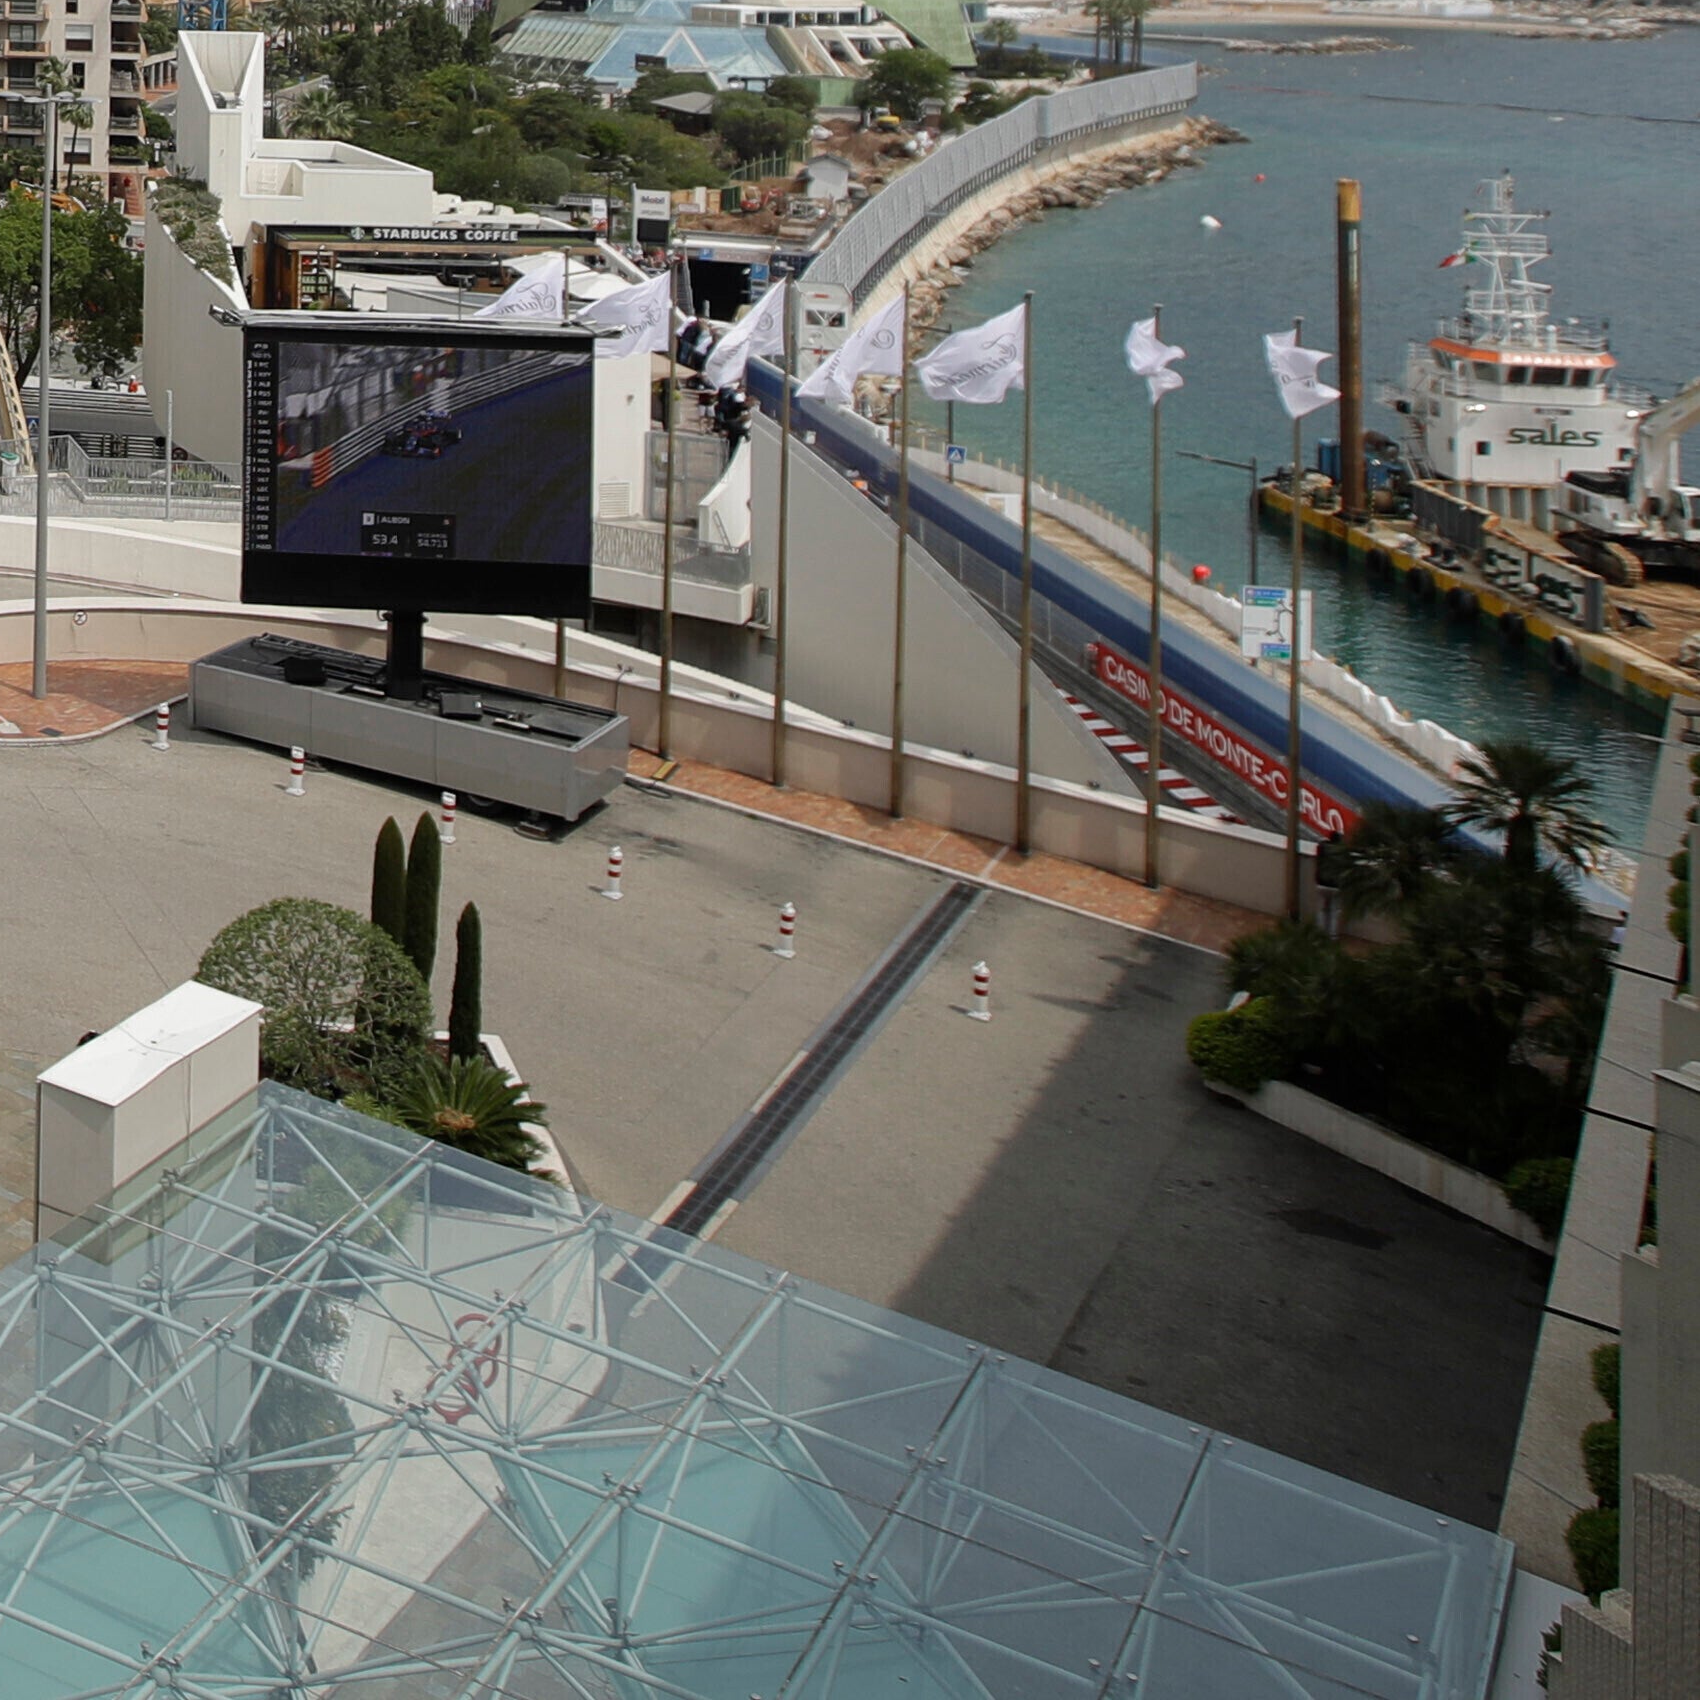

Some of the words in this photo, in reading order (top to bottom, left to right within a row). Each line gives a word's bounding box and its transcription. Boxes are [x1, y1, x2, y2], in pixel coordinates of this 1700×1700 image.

[372, 226, 458, 242] STARBUCKS
[464, 229, 519, 243] COFFEE
[1506, 417, 1603, 447] sales
[1168, 698, 1195, 735] DE
[1196, 716, 1345, 835] MONTE-CRLO
